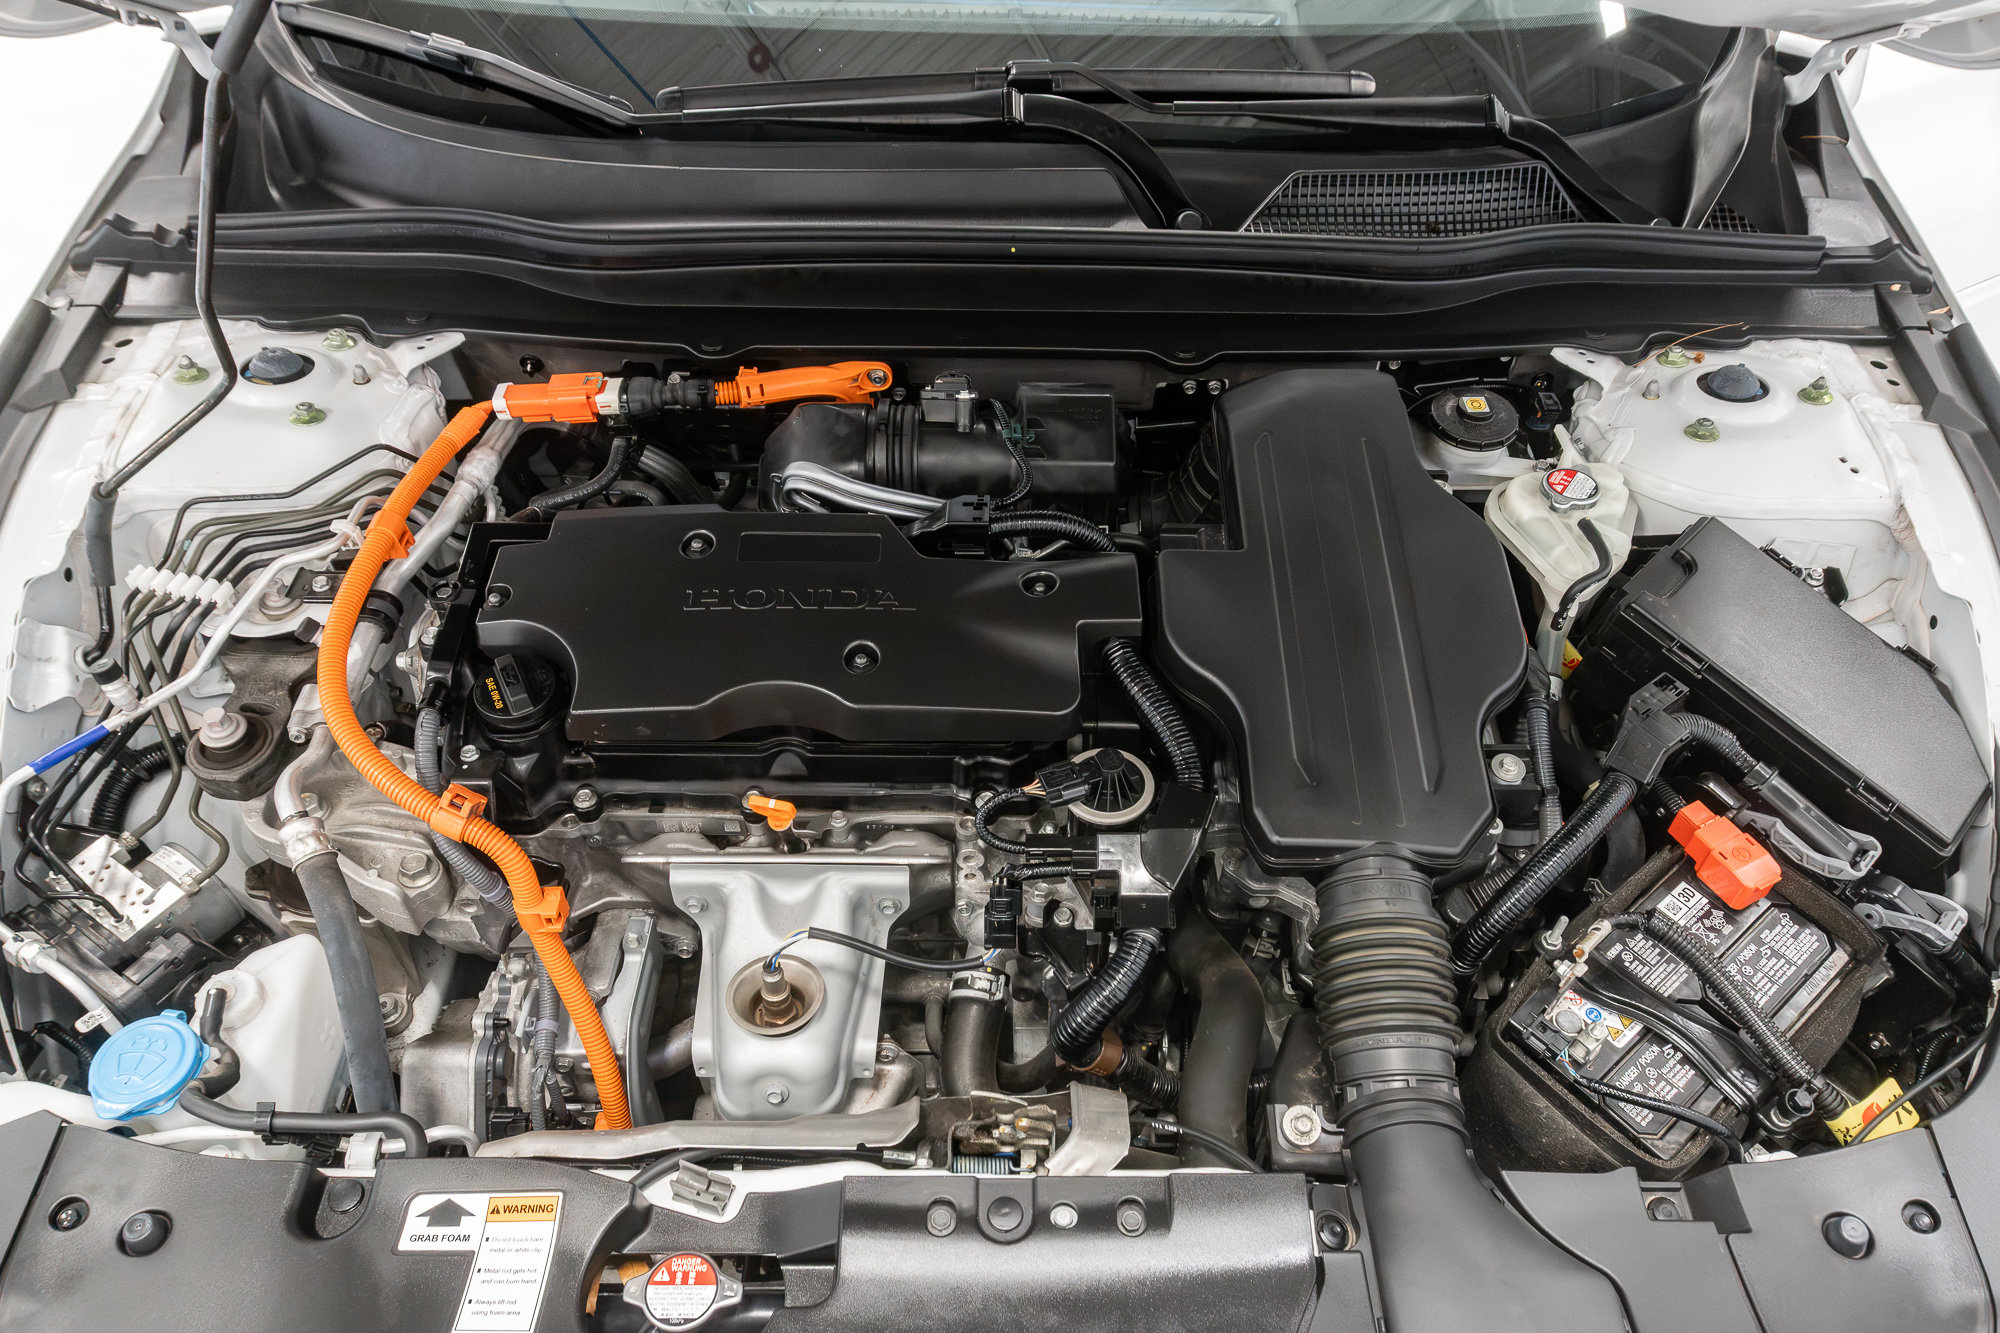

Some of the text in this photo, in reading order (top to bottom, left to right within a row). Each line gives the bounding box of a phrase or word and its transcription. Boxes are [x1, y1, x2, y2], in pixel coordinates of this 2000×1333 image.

[683, 588, 917, 611] HONDA
[485, 677, 504, 709] SAE 0W-20
[1677, 887, 1696, 903] 3D
[1615, 1043, 1662, 1089] DANGER/POISON
[503, 1203, 554, 1214] WARNING
[409, 1234, 471, 1242] GRAB FOAM
